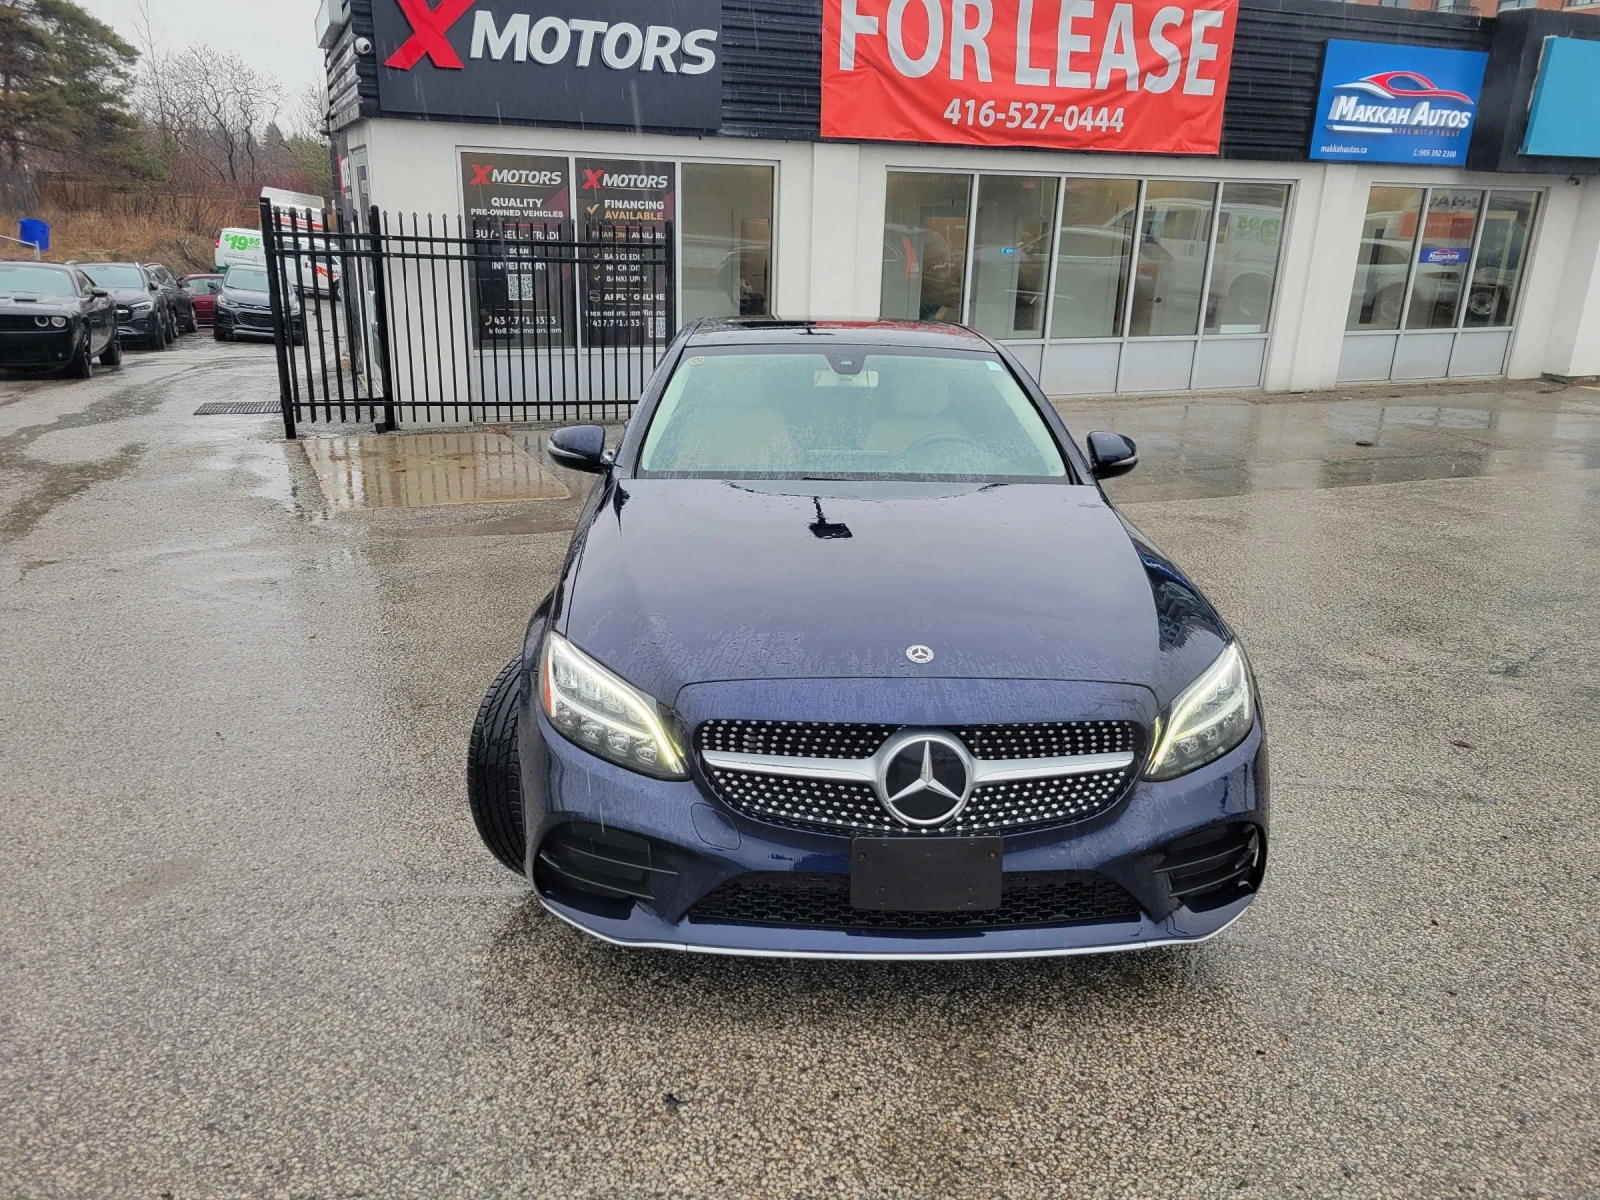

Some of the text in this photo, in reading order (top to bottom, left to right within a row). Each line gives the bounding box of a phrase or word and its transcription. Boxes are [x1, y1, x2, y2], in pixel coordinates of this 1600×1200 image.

[470, 10, 718, 74] MOTORS
[838, 0, 1225, 96] FOR LEASE
[943, 98, 1125, 132] 416-527-0444
[1320, 144, 1368, 154] makkahautos.ca
[492, 168, 562, 185] MOTORS
[602, 173, 669, 189] MOTORS
[491, 197, 543, 208] QUALITY
[604, 199, 665, 210] FINANCING
[470, 208, 564, 218] PRE-OWNED VEHICLES
[604, 210, 664, 221] AVAILABLE
[604, 293, 632, 301] APPL
